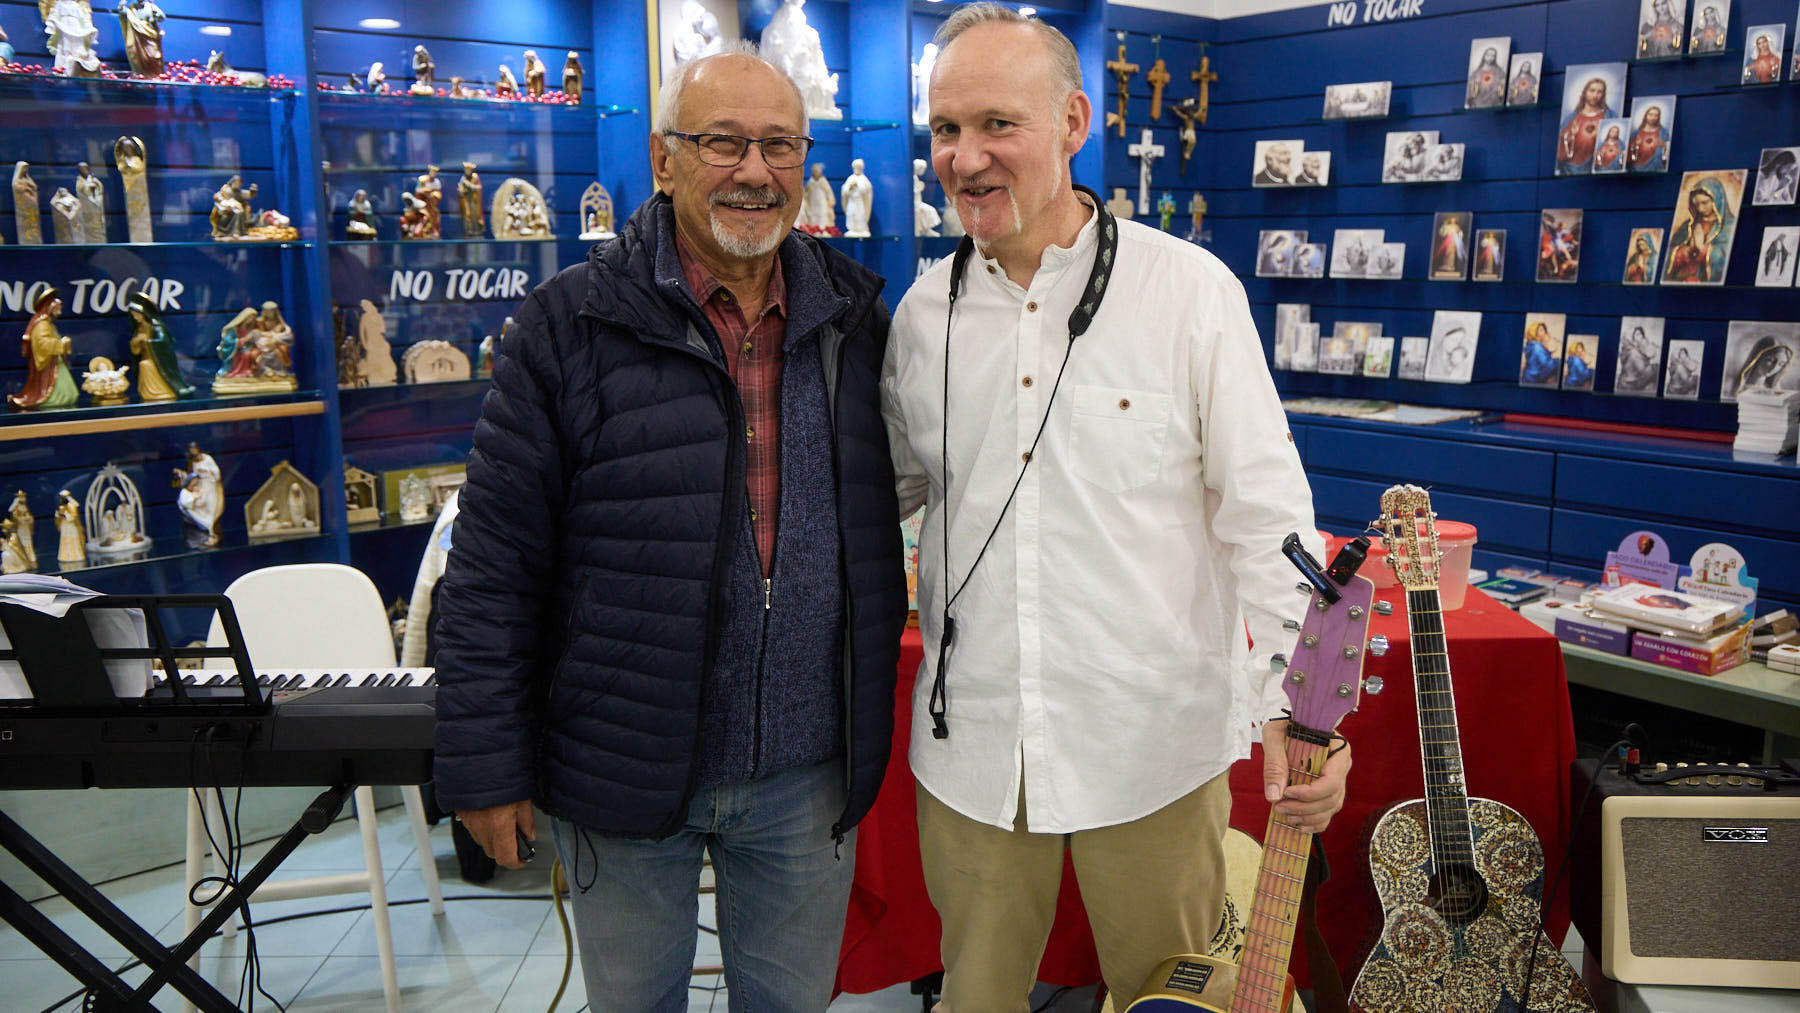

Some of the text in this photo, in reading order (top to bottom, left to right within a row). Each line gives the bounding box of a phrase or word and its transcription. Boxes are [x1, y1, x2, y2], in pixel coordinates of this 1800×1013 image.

[1328, 0, 1423, 27] NO TOCAR
[915, 256, 942, 282] N
[69, 277, 184, 314] TOCAR
[390, 268, 529, 301] NO TOCAR
[1706, 830, 1766, 839] VOX
